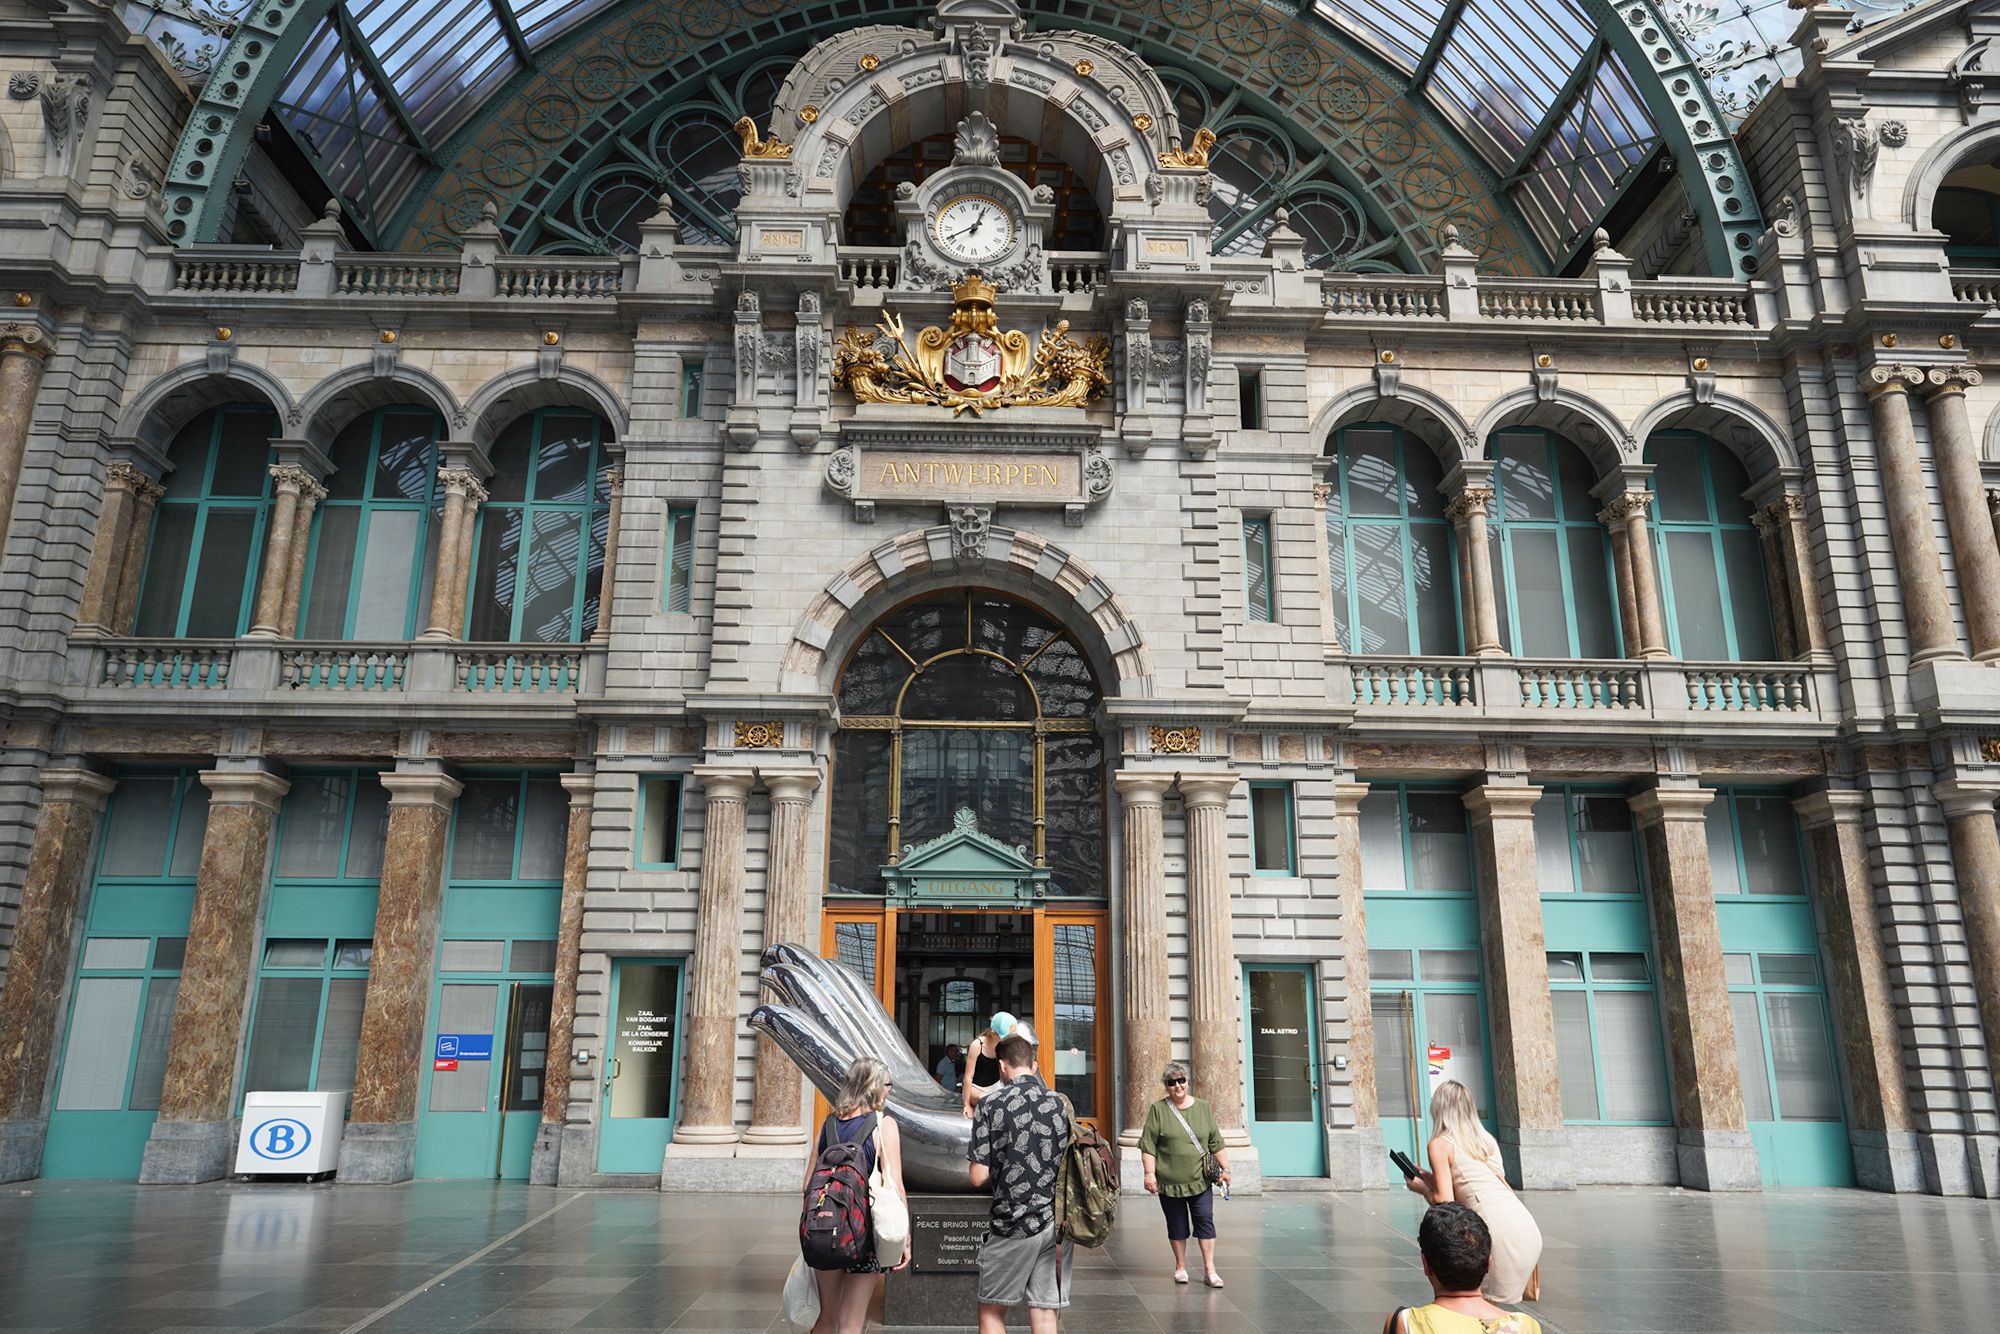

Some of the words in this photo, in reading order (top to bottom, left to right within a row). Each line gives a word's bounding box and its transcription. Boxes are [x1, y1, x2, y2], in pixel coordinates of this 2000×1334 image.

[761, 233, 801, 245] ANNO
[879, 461, 1059, 486] ANTWERPEN
[928, 880, 1005, 895] UITGANG
